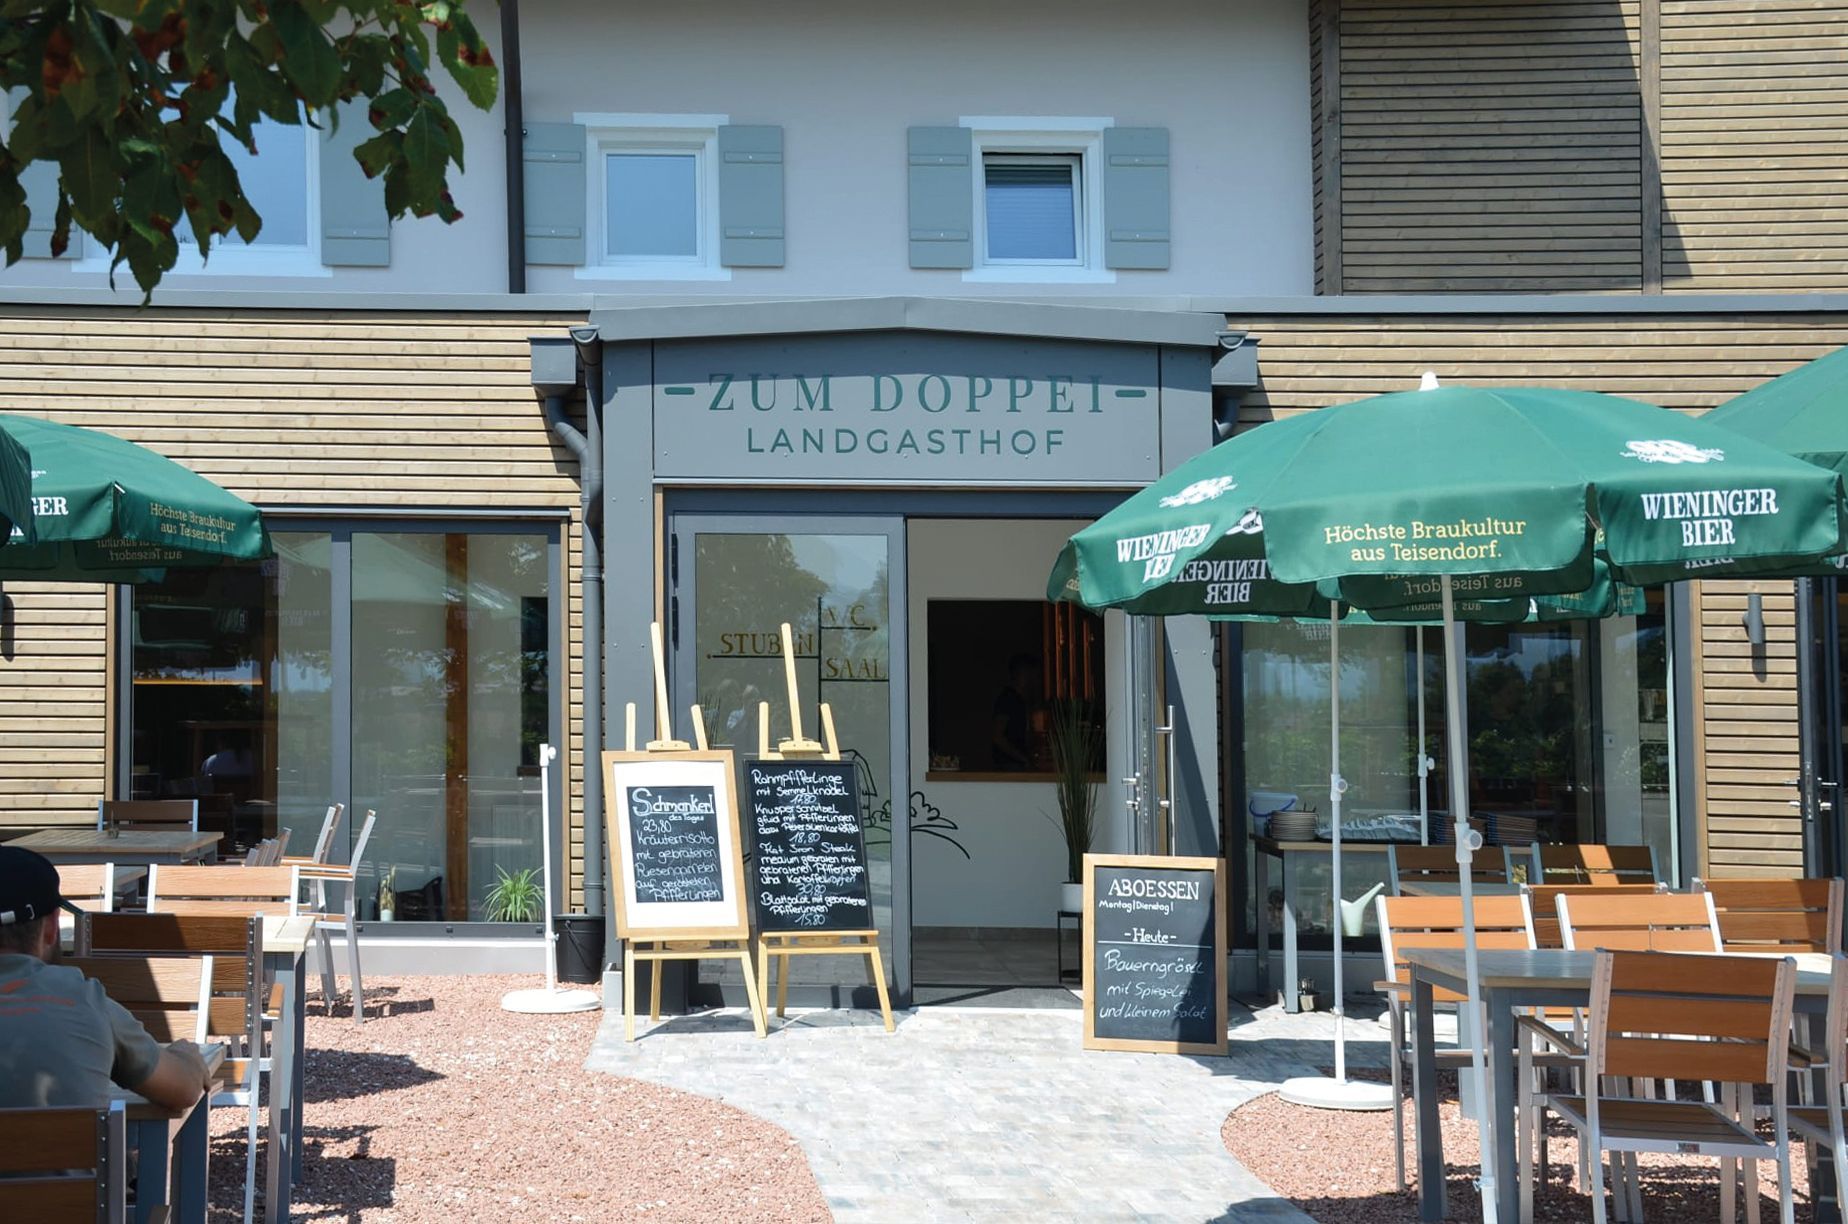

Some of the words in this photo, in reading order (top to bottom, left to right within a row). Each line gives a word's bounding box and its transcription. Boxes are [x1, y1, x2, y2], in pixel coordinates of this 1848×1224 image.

[708, 373, 835, 411] ZUM
[871, 373, 1104, 413] DOPPEI
[747, 427, 1065, 456] LANDGASTHOF
[150, 503, 189, 521] Höchste
[1641, 488, 1780, 520] WIENINGER
[160, 522, 177, 535] aus
[1323, 523, 1407, 545] Höchste
[1411, 517, 1527, 540] Braukultur
[1681, 518, 1736, 547] BIER
[1351, 547, 1386, 562] aus
[1390, 540, 1503, 562] Teisendorf.
[720, 633, 813, 655] STUBN
[826, 657, 887, 679] SAAL
[632, 787, 715, 817] Schmankerl
[756, 786, 771, 796] mit
[642, 819, 672, 834] 23,80
[636, 849, 655, 860] mit
[841, 855, 856, 864] mit
[1108, 878, 1200, 900] ABOESSEN
[1107, 980, 1132, 997] mit
[1099, 1001, 1126, 1018] und
